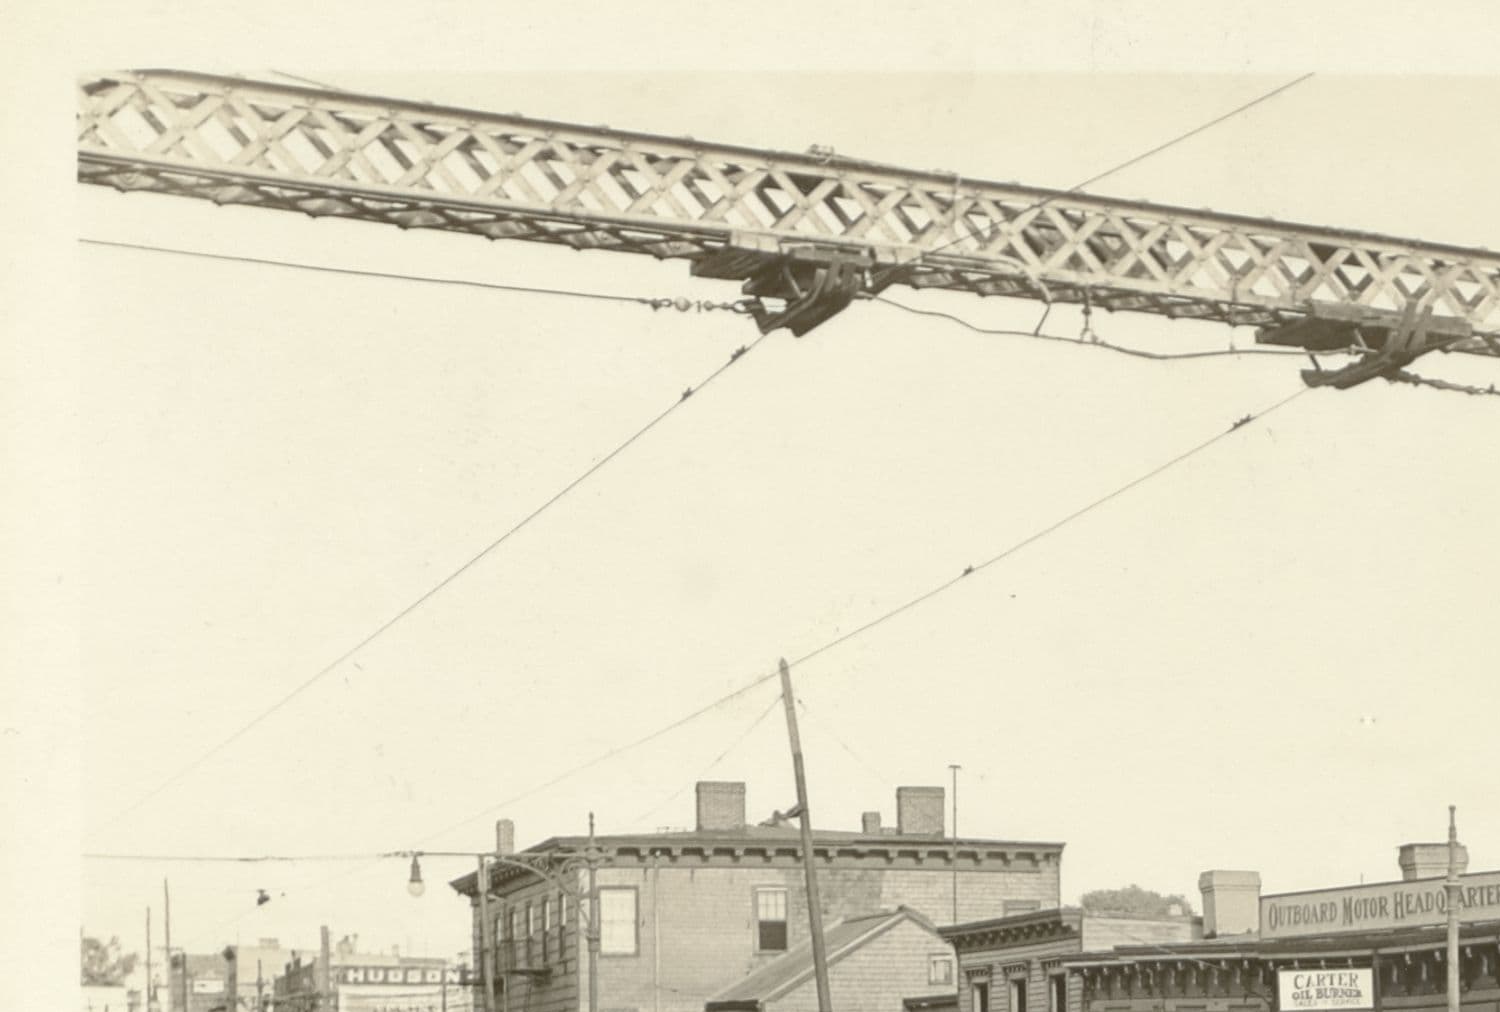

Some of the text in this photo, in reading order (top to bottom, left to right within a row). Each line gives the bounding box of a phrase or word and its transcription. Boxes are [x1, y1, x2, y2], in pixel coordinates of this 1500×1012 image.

[1268, 901, 1338, 931] OUTBOARD
[1342, 896, 1389, 926] MOTOR
[1294, 972, 1358, 989] CARTER
[1291, 987, 1363, 1001] OIL BURNER
